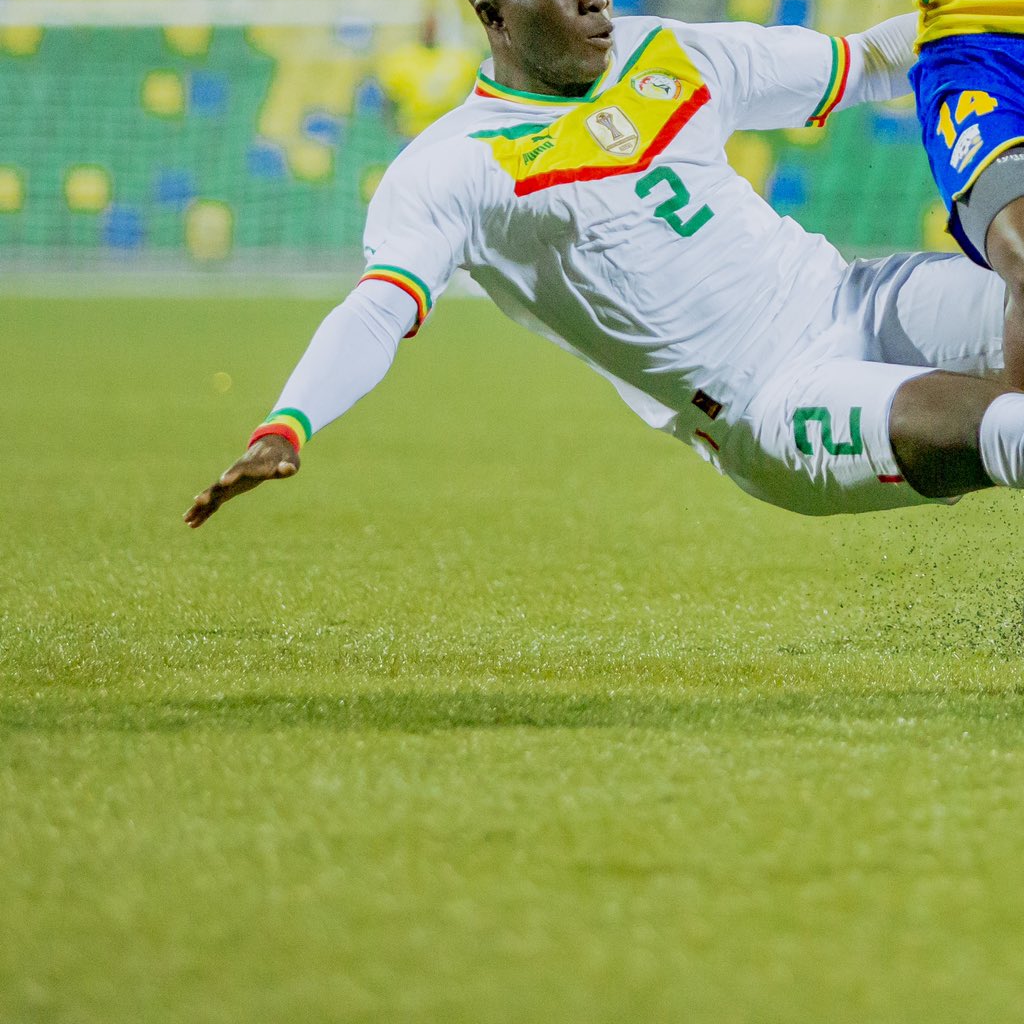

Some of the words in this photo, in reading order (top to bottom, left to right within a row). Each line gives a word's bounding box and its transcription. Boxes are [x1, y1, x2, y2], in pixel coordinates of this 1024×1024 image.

[936, 90, 998, 150] 14
[634, 165, 715, 238] 2
[793, 406, 863, 455] 2
